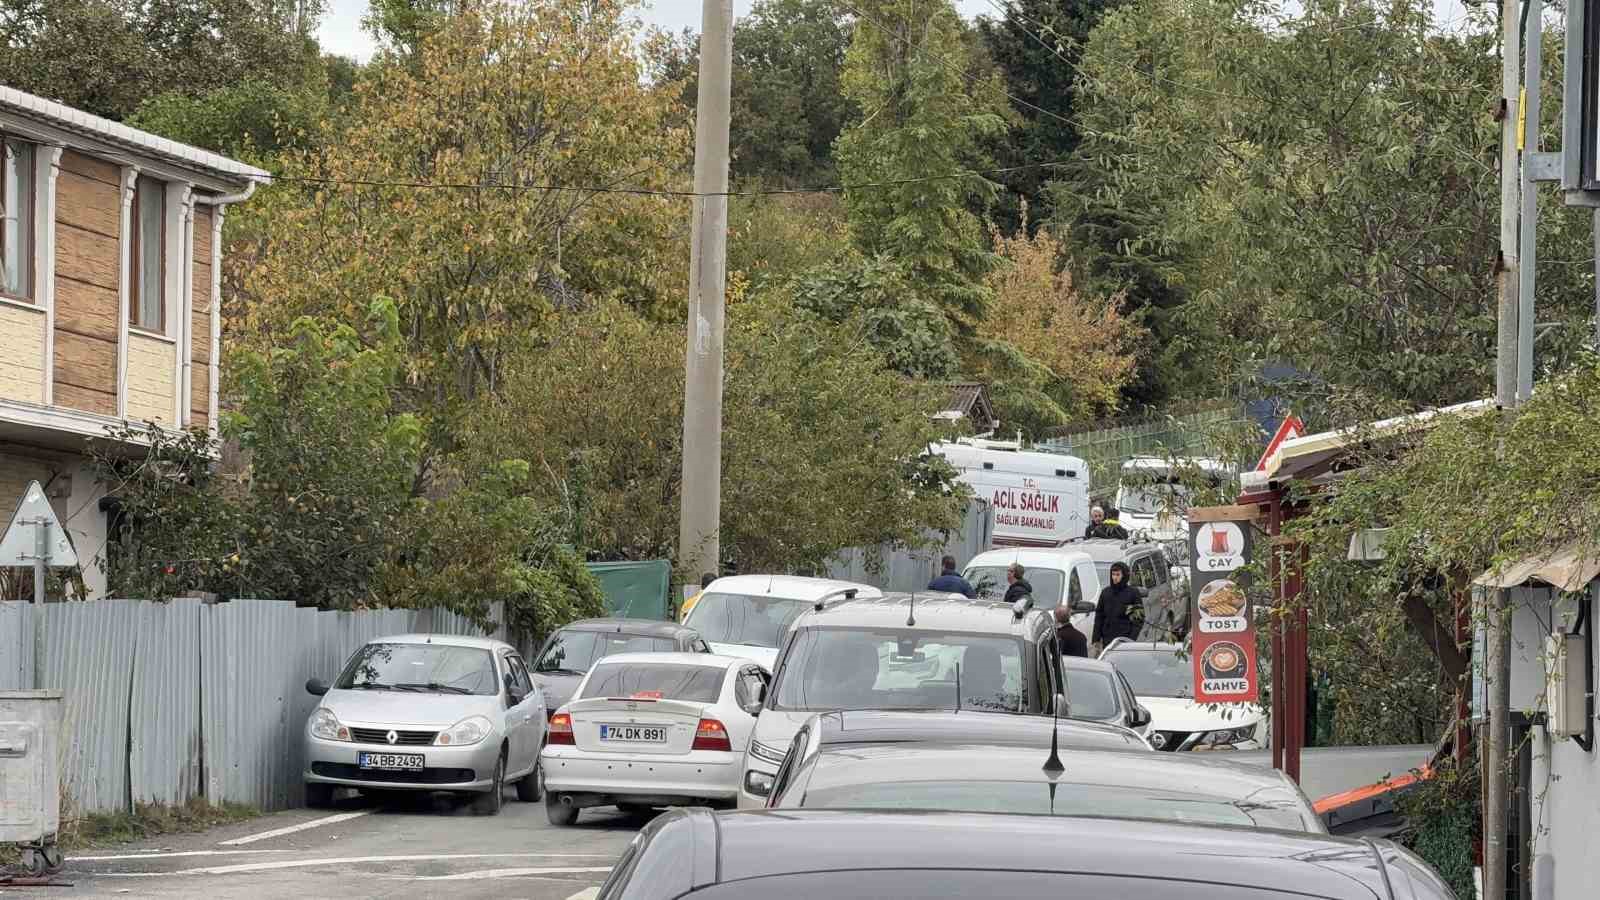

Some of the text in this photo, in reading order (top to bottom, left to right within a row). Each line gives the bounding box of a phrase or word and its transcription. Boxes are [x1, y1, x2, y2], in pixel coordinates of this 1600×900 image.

[1020, 490, 1059, 513] SAĞLIK
[1206, 620, 1240, 629] TOST
[1204, 681, 1247, 691] KAHVE
[609, 728, 623, 739] 74
[625, 728, 640, 739] DK
[643, 729, 664, 740] 891
[367, 755, 423, 768] 34 BB 2492
